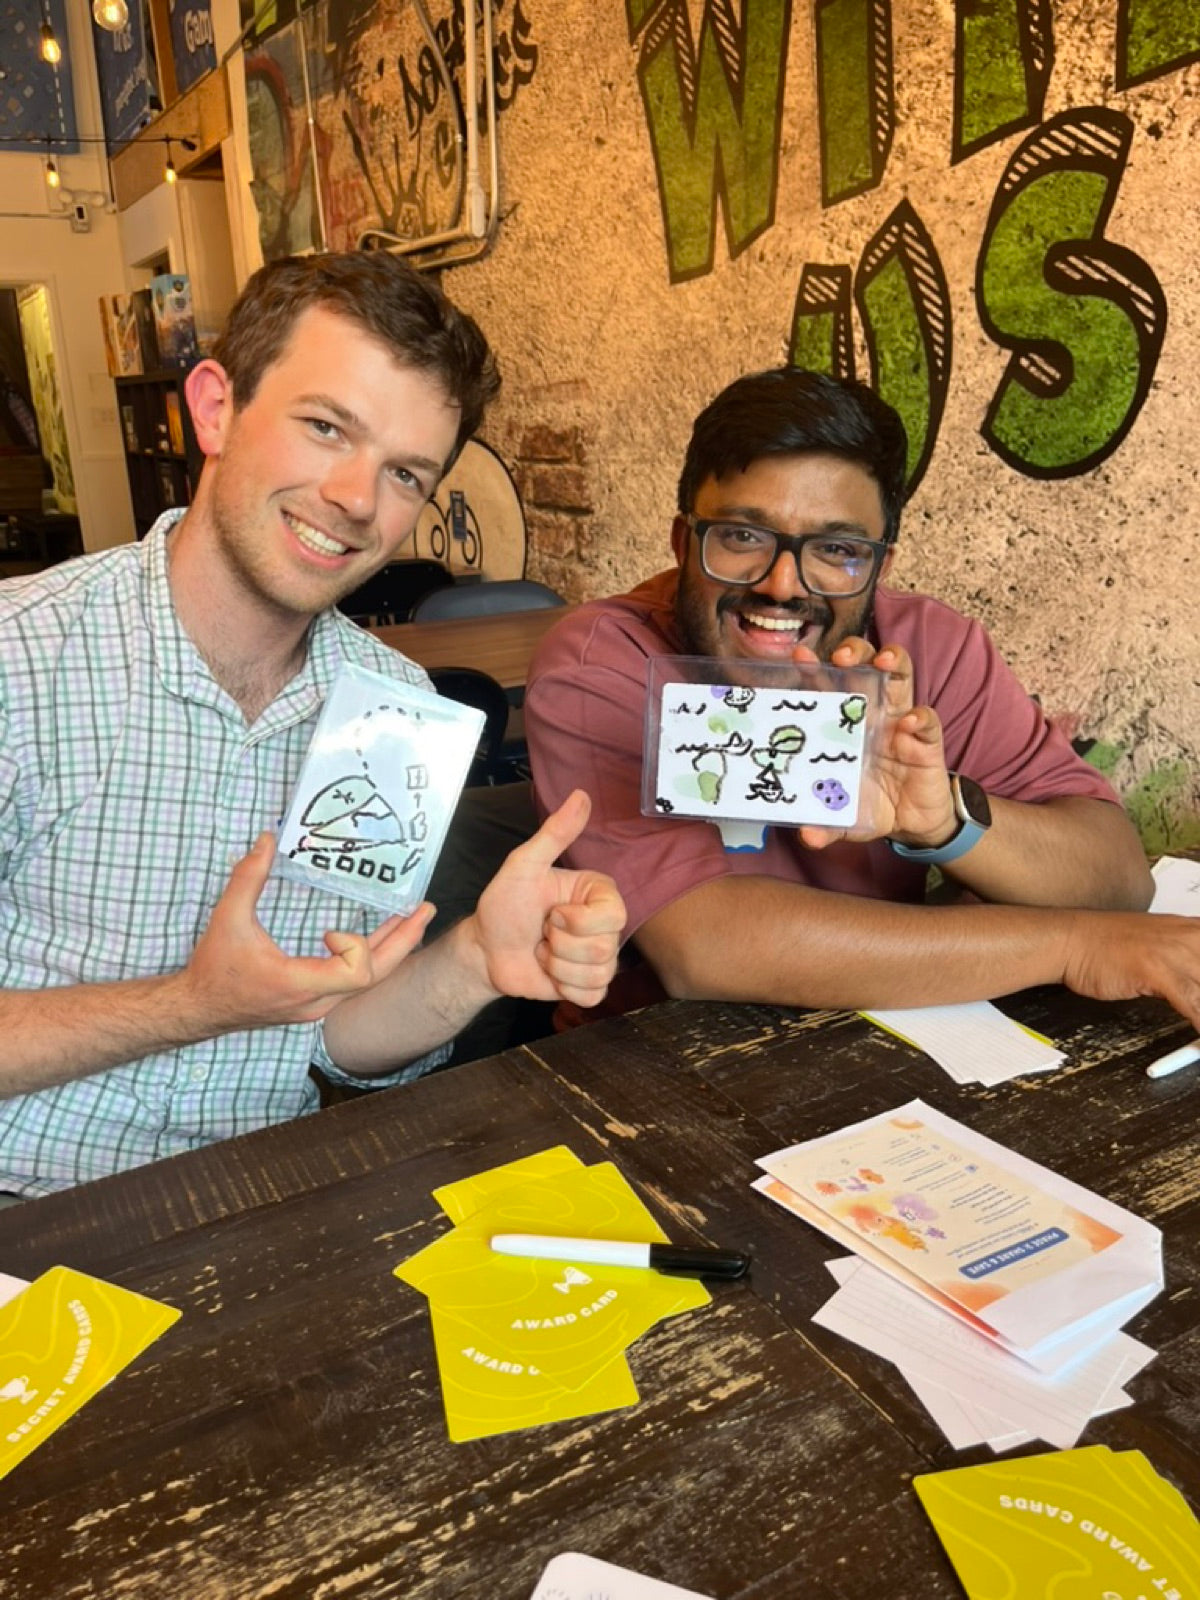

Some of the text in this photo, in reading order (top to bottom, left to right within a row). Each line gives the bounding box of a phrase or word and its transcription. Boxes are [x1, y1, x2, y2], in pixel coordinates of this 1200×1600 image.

[511, 1289, 619, 1330] AWARD CARD
[6, 1387, 67, 1443] SECRET
[62, 1336, 92, 1385] AWARD
[460, 1346, 524, 1376] AWARD
[999, 1494, 1154, 1572] AWARD CARDS
